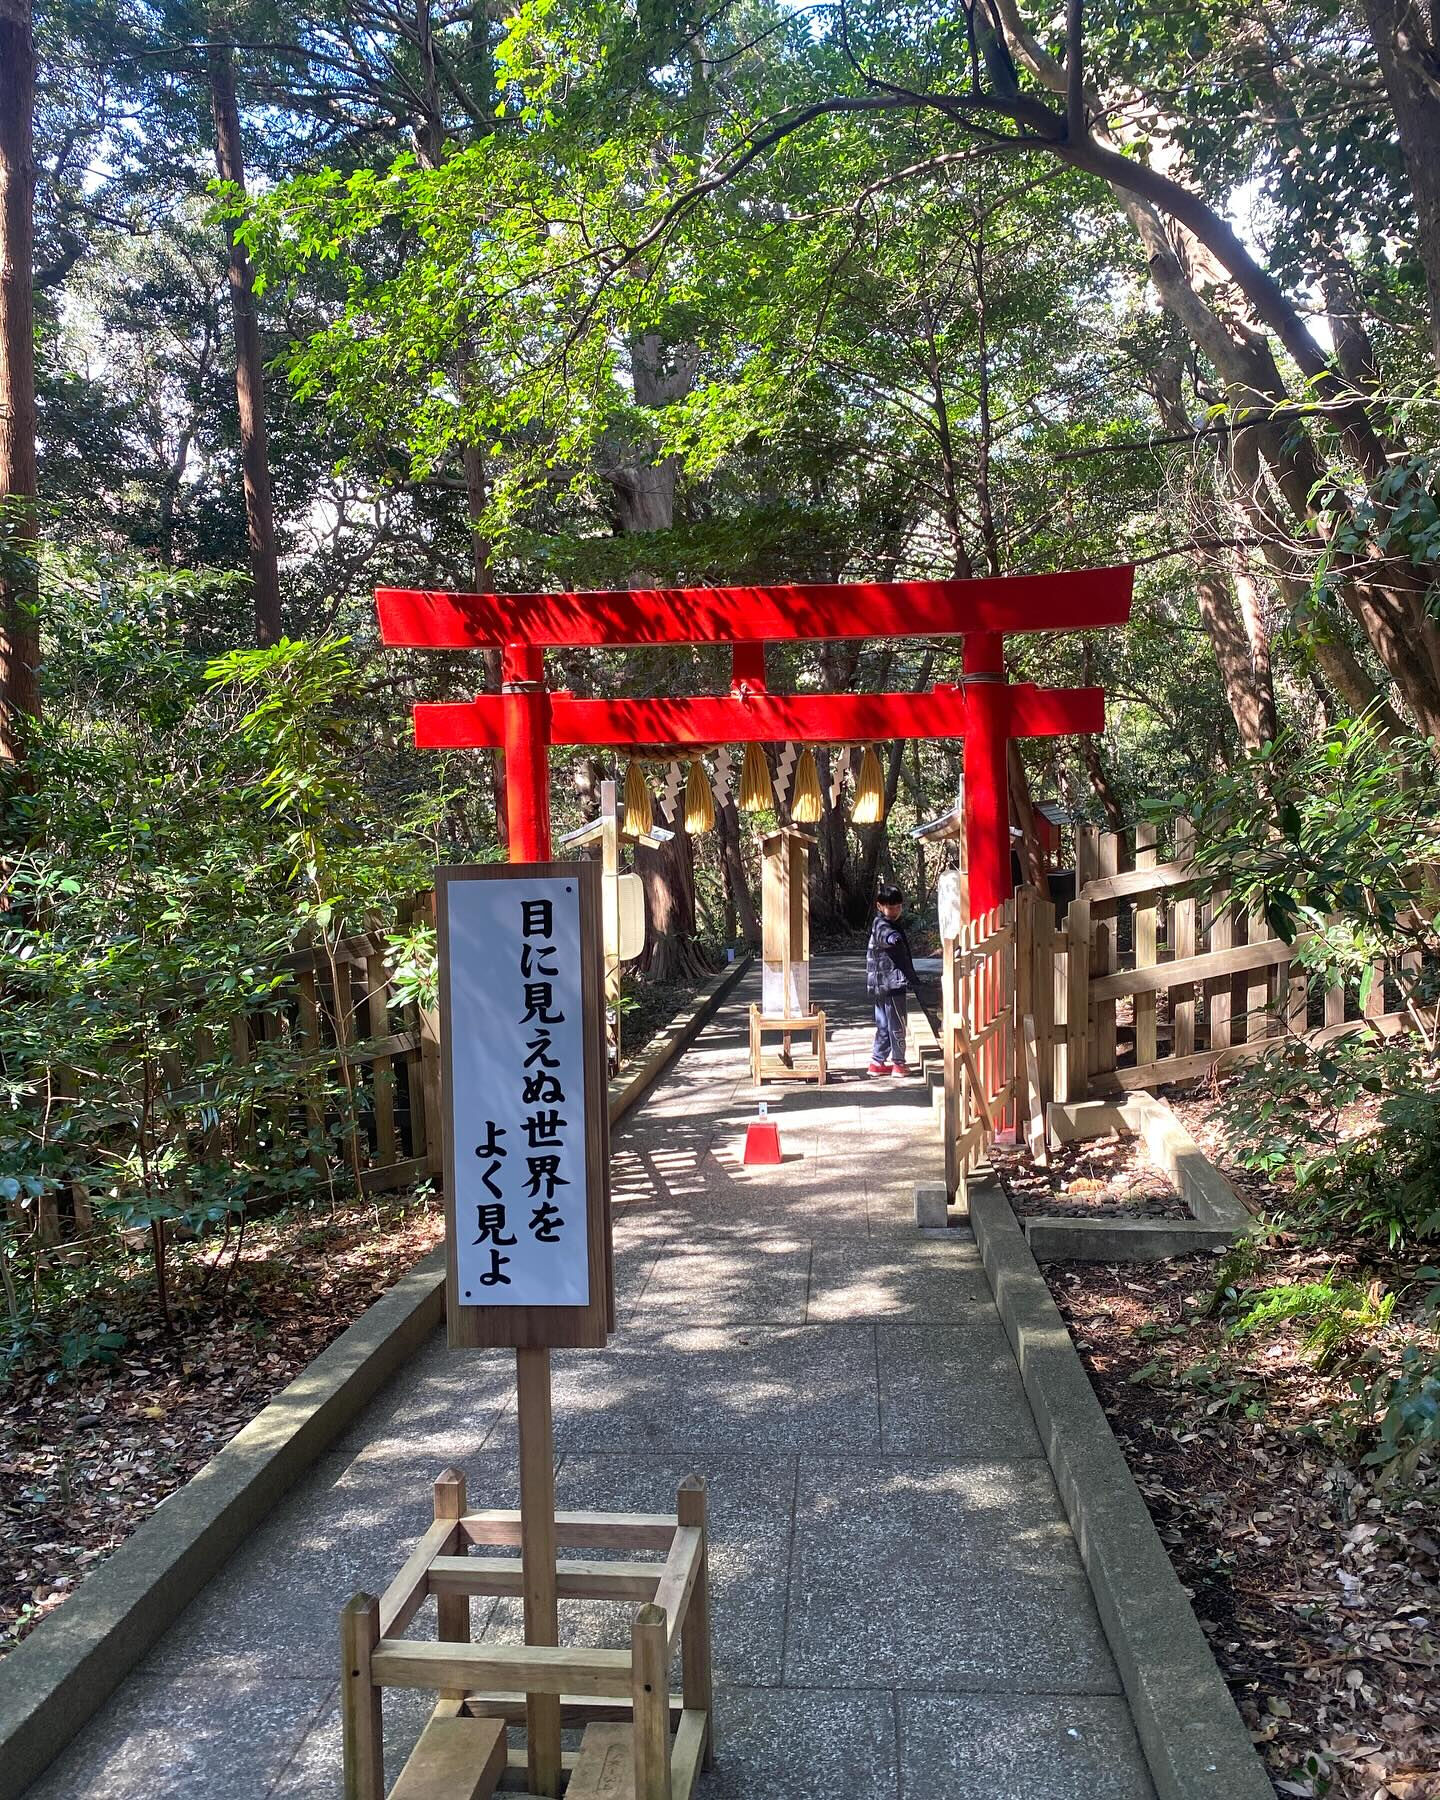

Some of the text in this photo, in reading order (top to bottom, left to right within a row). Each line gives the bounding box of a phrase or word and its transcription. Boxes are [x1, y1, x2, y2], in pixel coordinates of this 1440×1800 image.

[518, 899, 571, 1243] 目に見えぬ世界を
[472, 1121, 518, 1286] よく見よ
